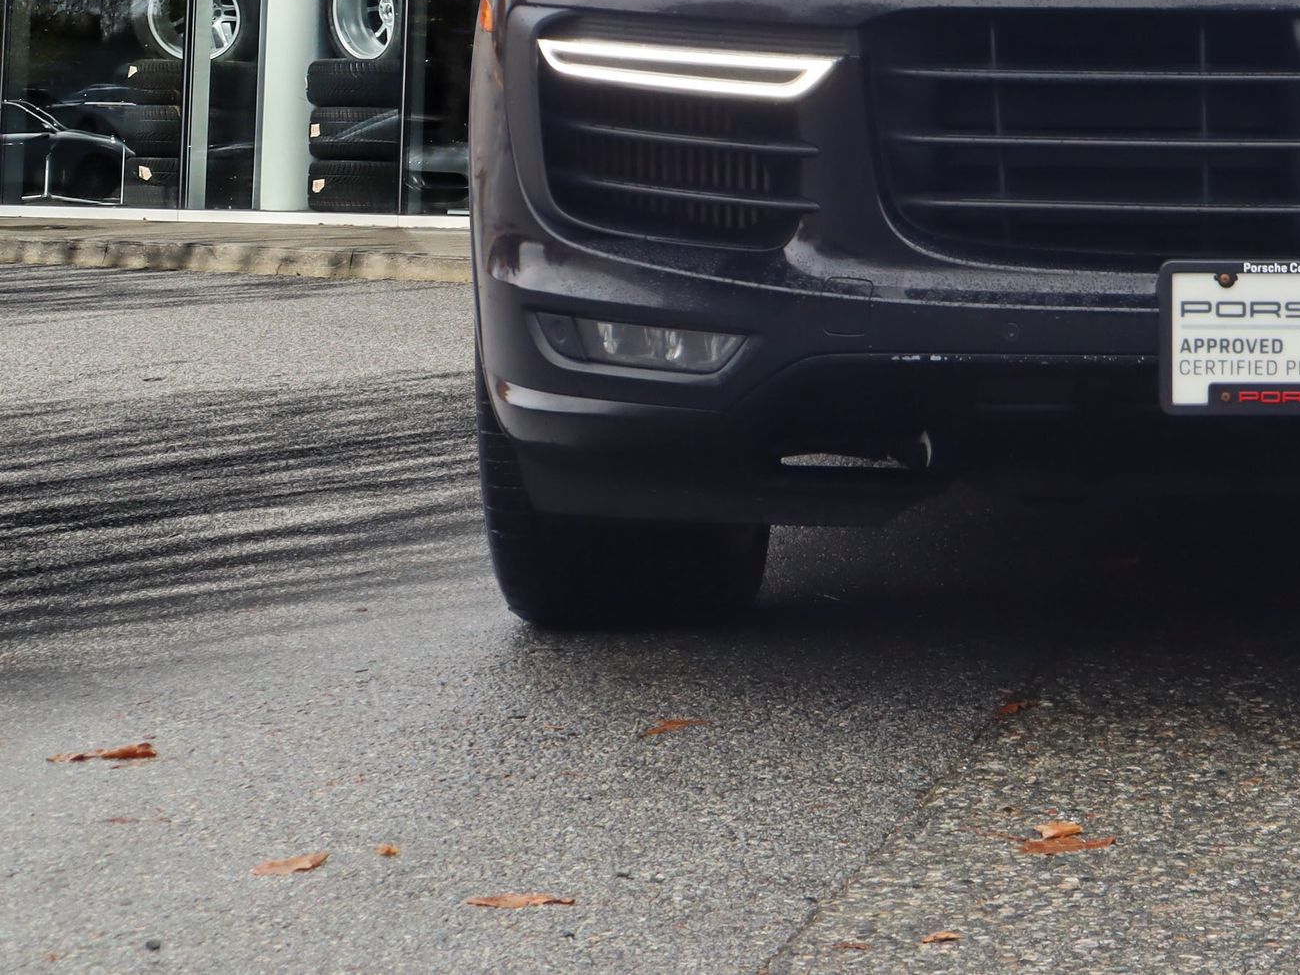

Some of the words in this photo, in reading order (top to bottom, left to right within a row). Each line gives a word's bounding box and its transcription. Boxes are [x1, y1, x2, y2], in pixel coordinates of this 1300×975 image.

[1243, 262, 1288, 273] Porsche
[1180, 338, 1284, 354] APPROVED
[1179, 360, 1278, 376] CERTIFIED
